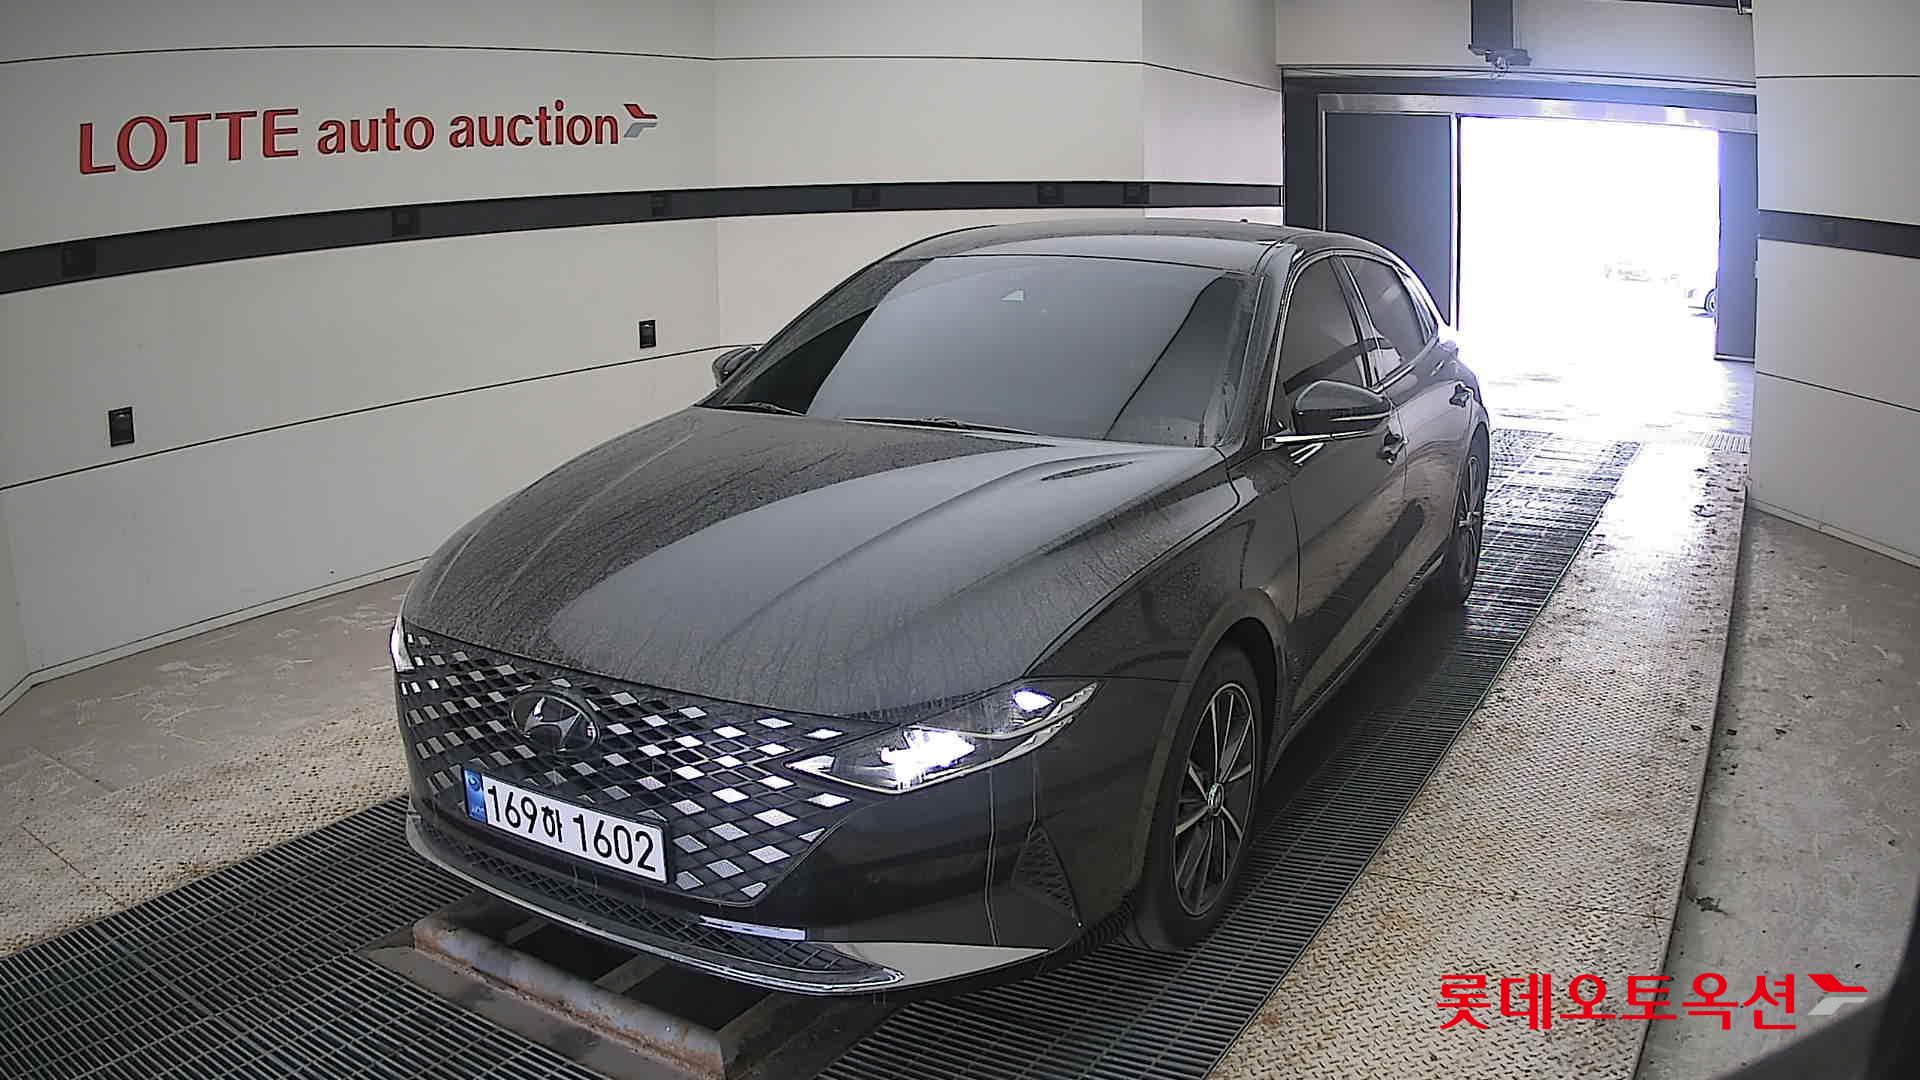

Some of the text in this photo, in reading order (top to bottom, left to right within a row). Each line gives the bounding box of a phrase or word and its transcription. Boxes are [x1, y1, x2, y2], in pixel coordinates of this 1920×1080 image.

[79, 99, 620, 175] LOTTE auto auction
[487, 785, 656, 873] 169하 1602
